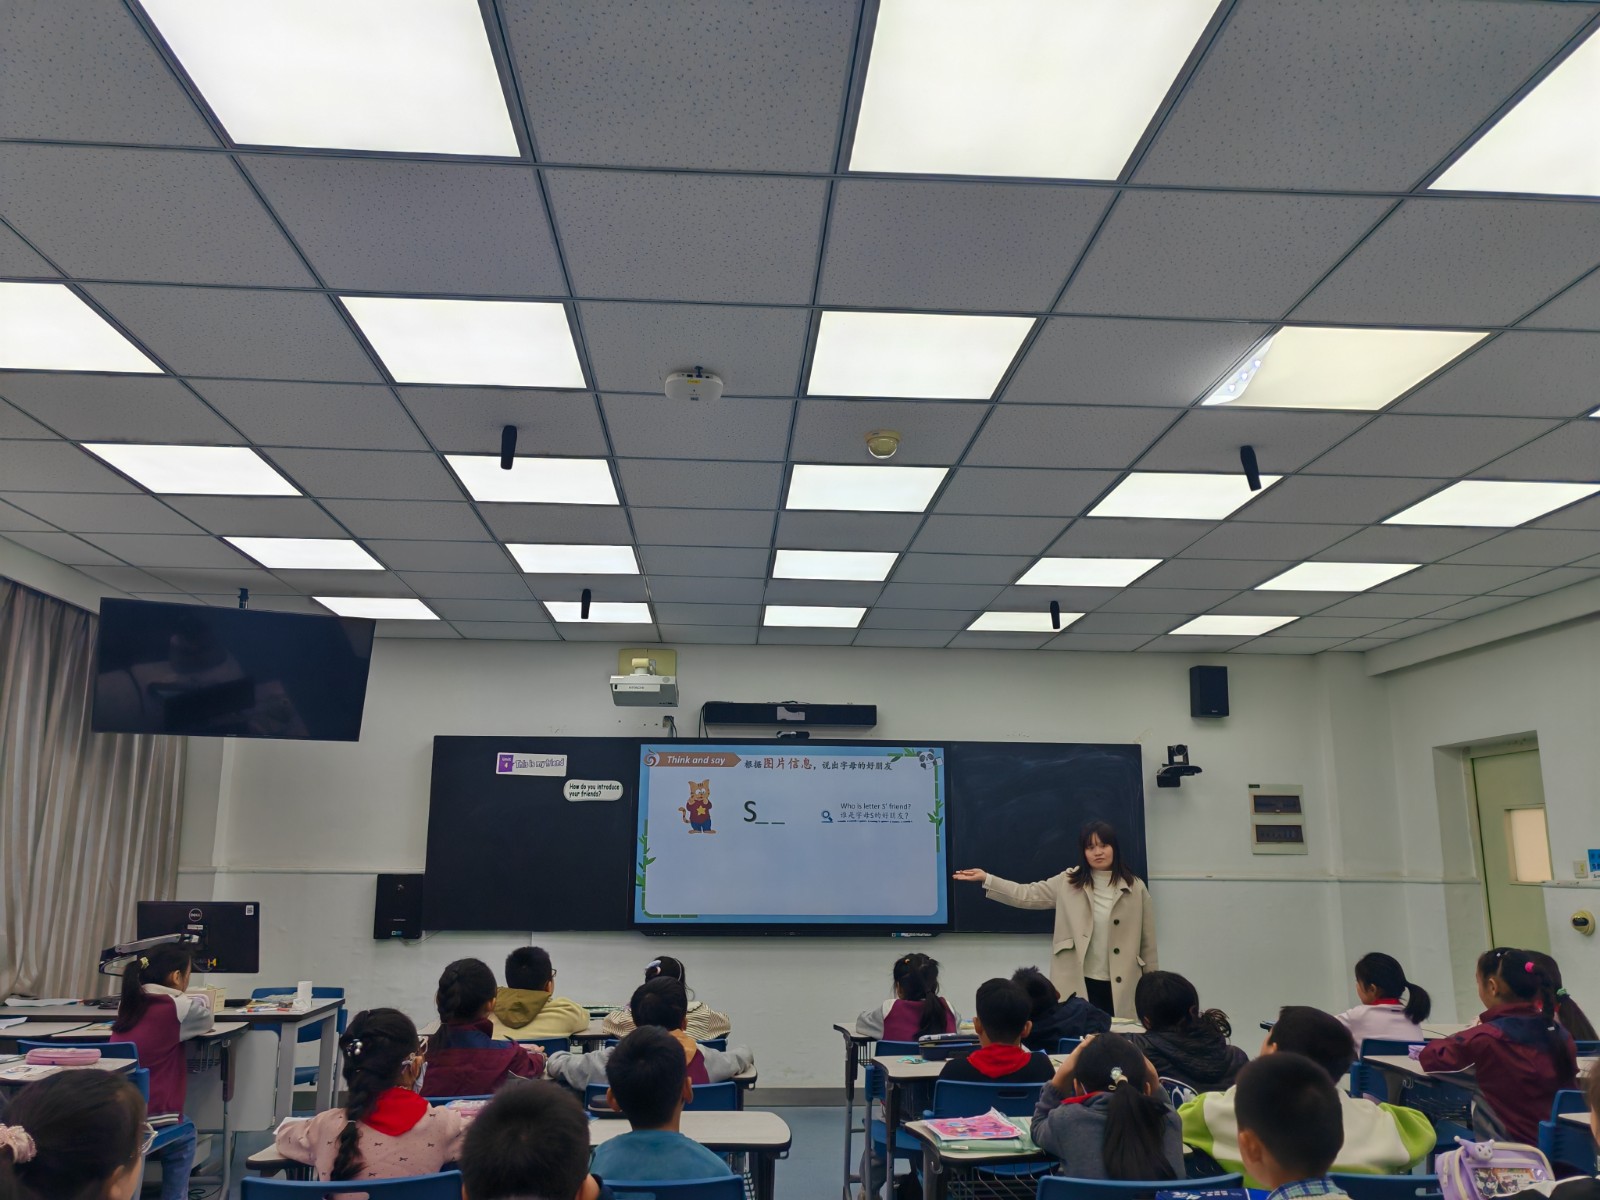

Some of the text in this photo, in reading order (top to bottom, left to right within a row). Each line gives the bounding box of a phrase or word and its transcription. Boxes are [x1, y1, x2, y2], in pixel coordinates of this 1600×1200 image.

[515, 758, 565, 769] This is my friend
[667, 755, 726, 766] Think and say
[587, 784, 596, 792] you
[597, 783, 620, 791] introduce
[581, 790, 602, 798] friends?
[840, 802, 856, 810] Who
[857, 802, 862, 810] is
[863, 802, 880, 810] letter
[889, 802, 912, 810] friend?
